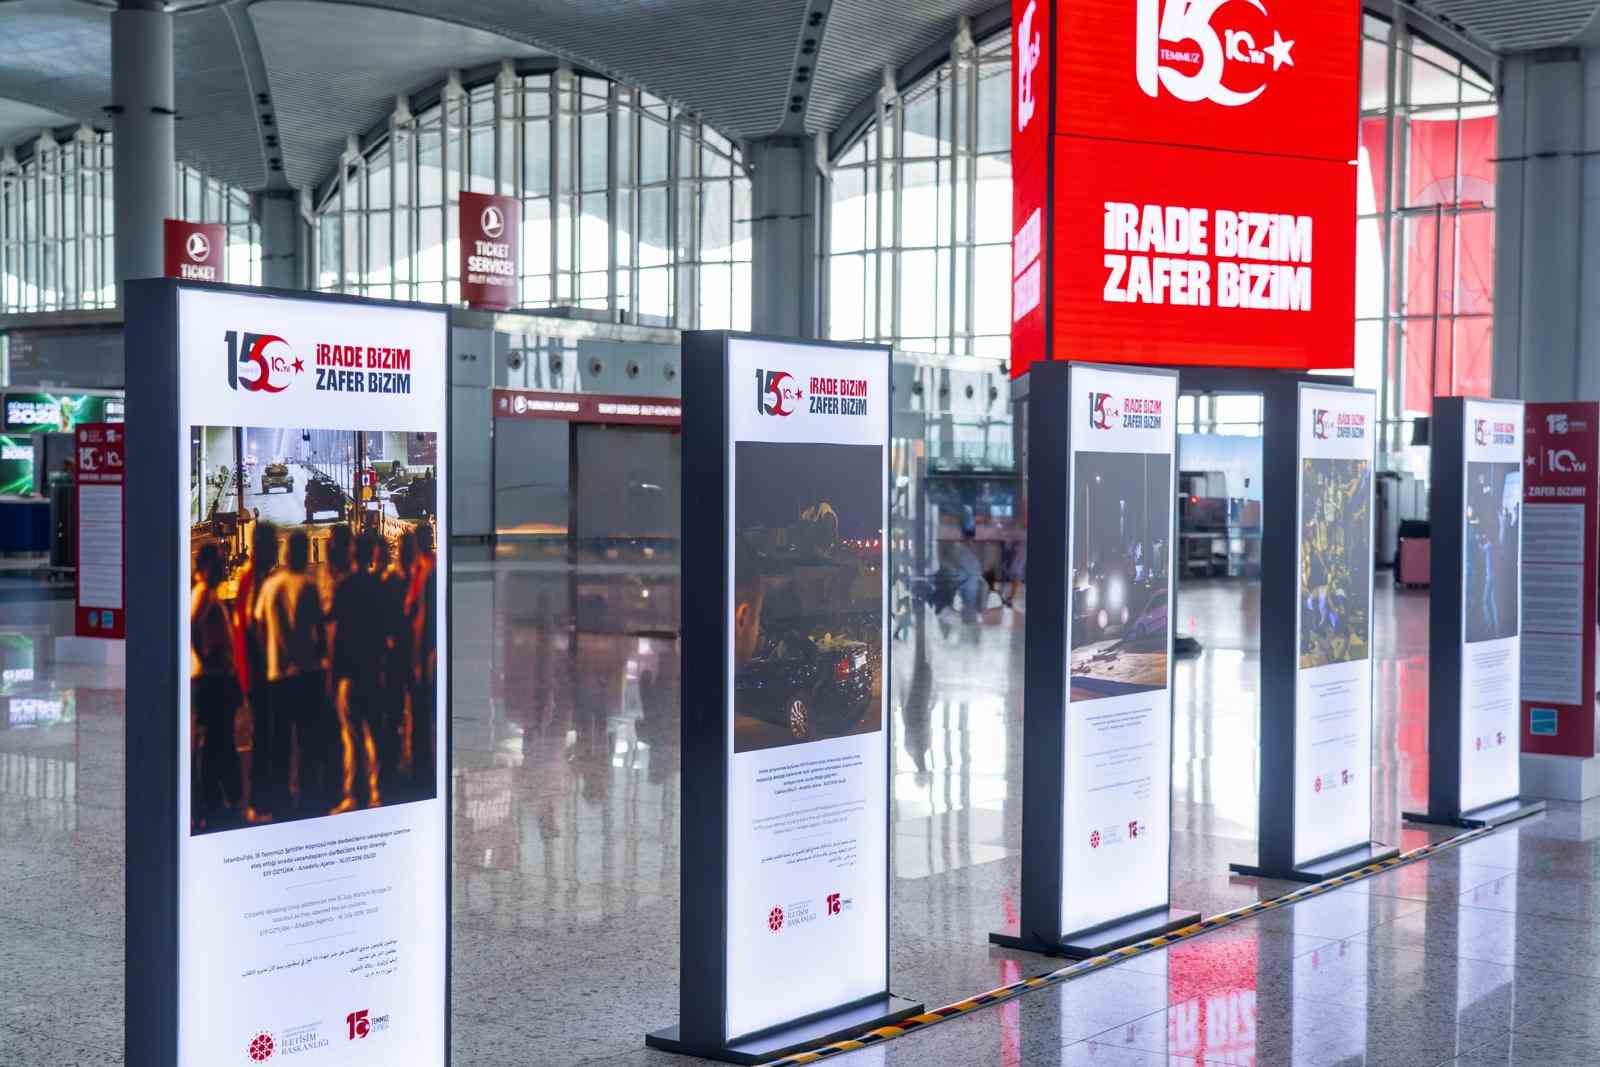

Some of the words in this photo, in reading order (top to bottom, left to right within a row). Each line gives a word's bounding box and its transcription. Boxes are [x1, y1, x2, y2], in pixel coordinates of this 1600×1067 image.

[475, 240, 509, 258] TICKET
[1103, 254, 1211, 307] ZAFER
[224, 331, 280, 392] 15
[316, 368, 364, 392] ZAFER
[809, 396, 838, 414] ZAFER
[346, 1009, 370, 1041] 15
